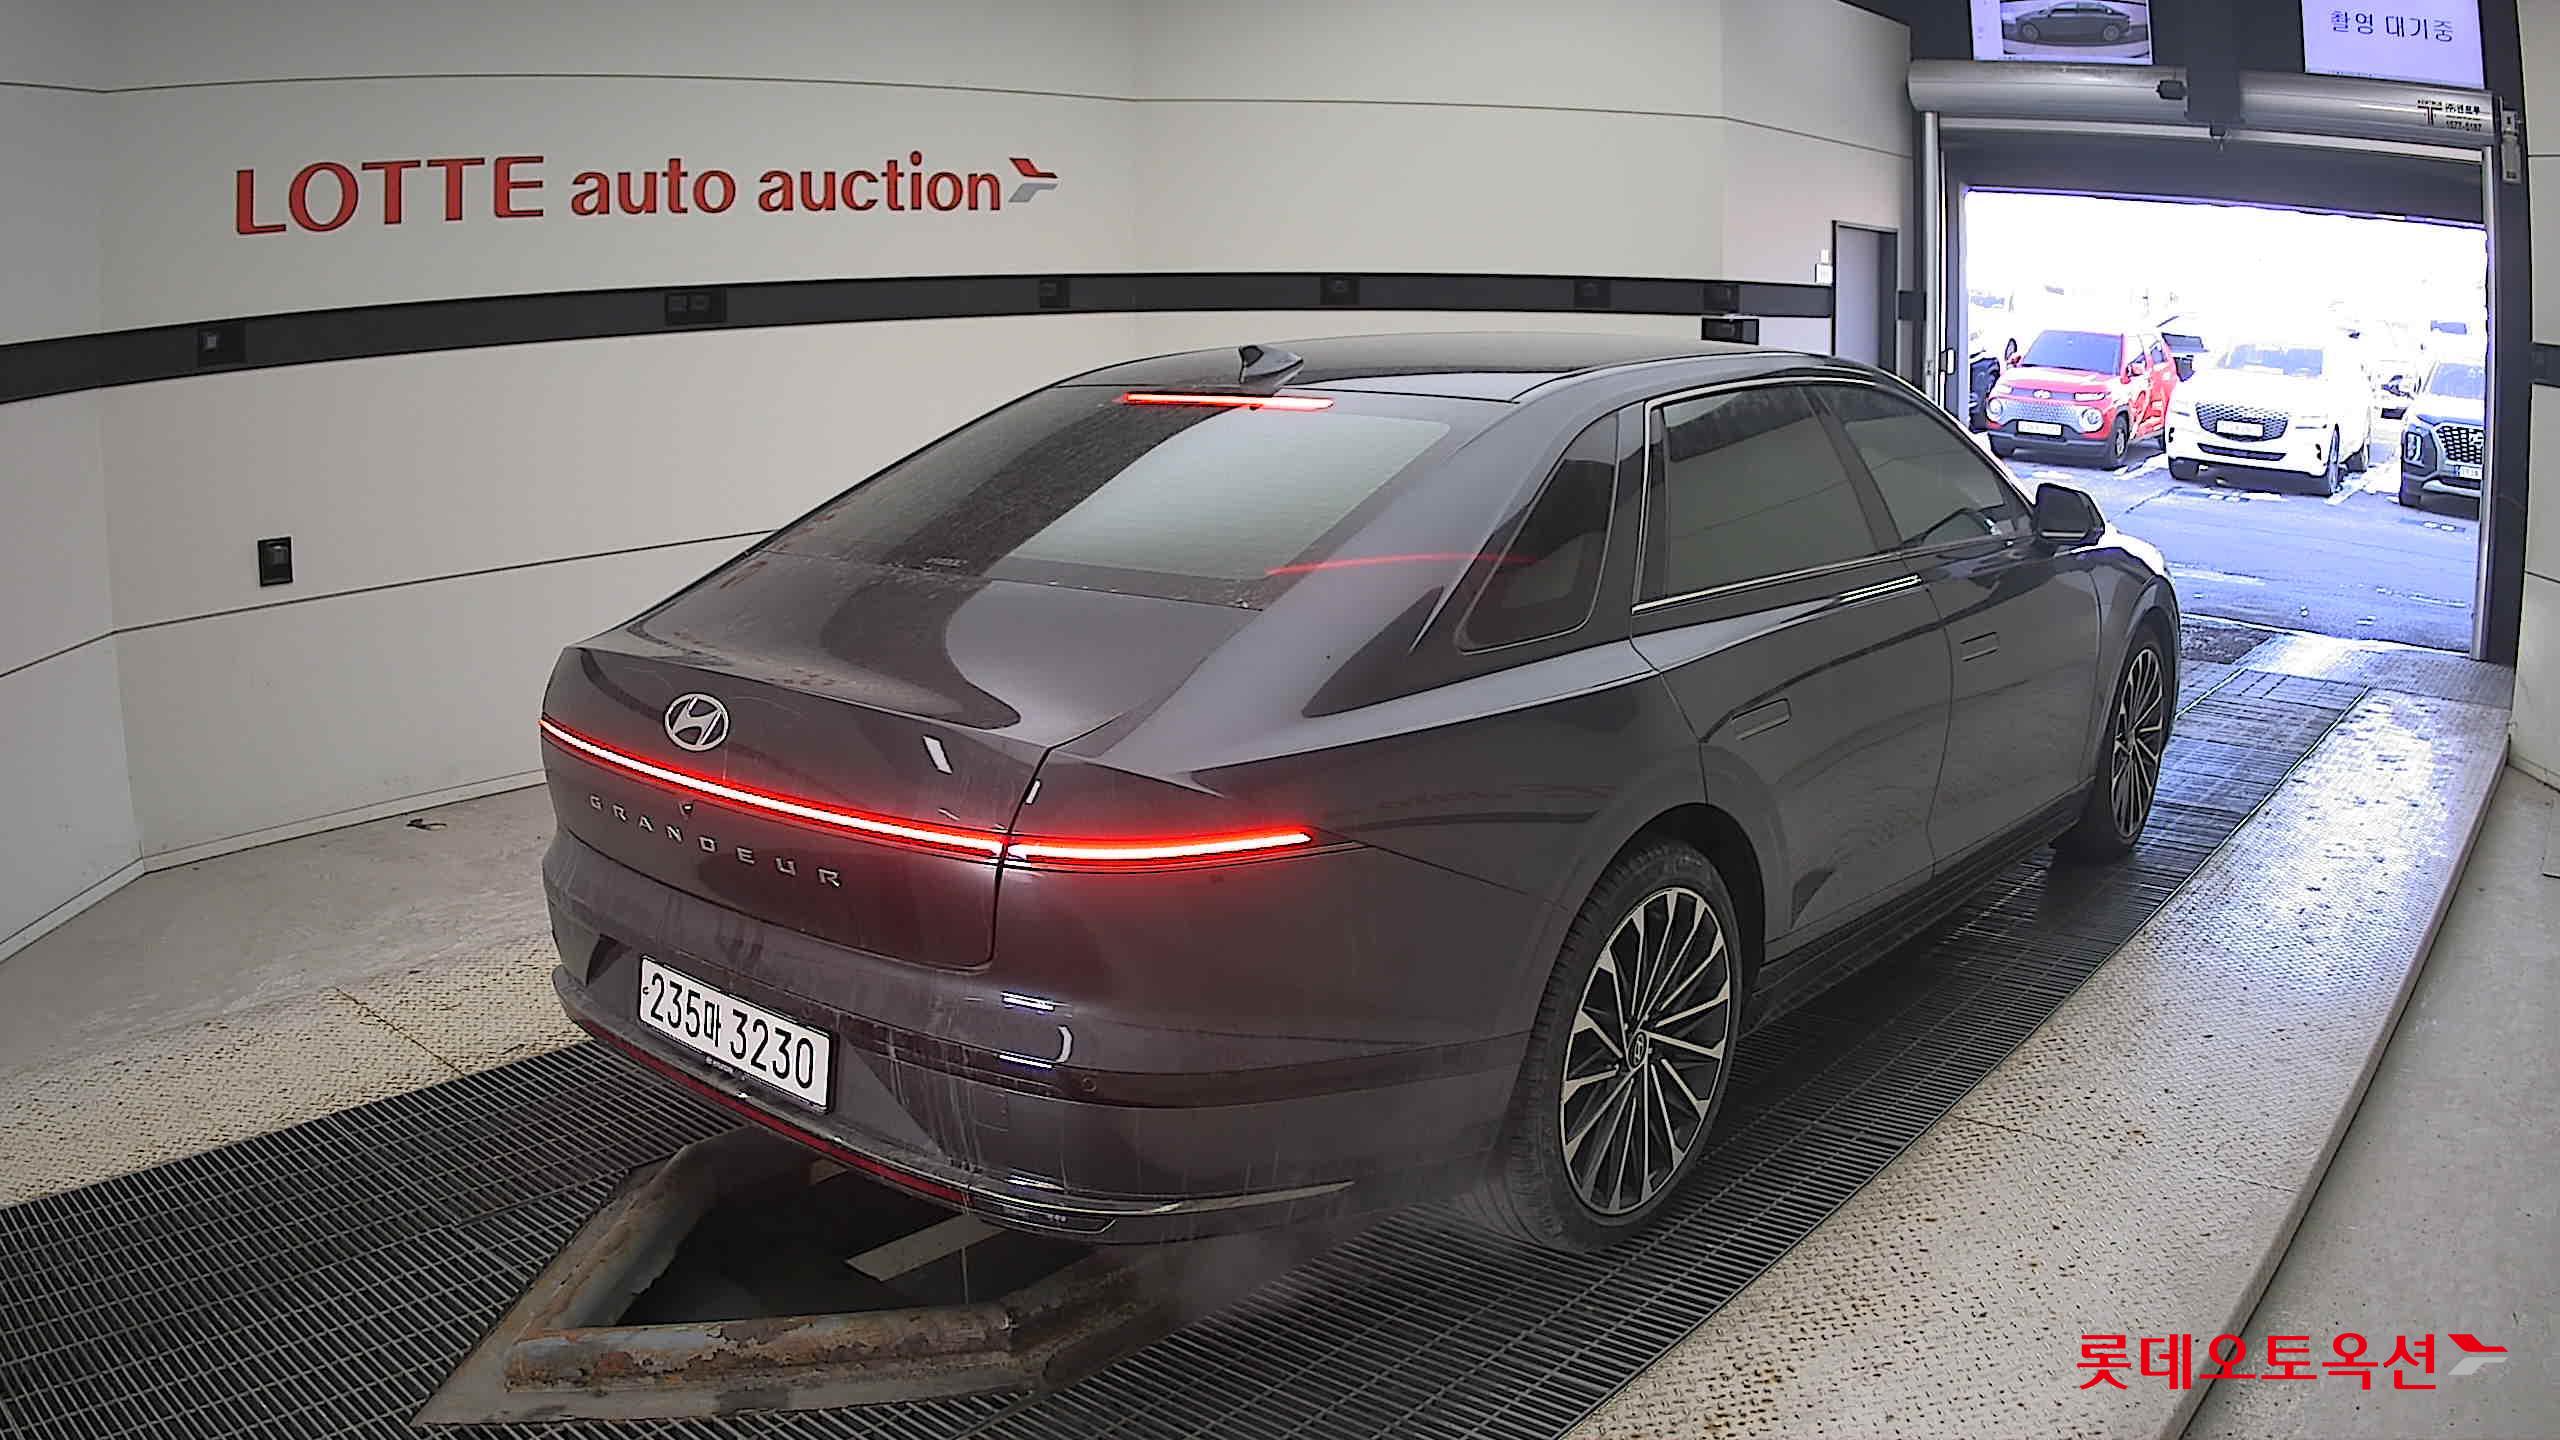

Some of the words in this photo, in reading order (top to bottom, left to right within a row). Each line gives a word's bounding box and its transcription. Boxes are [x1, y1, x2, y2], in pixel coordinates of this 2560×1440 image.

[2331, 10, 2374, 35] 촬영
[2385, 15, 2453, 42] 대기중
[237, 156, 544, 235] LOTTE
[572, 159, 736, 214] auto
[759, 151, 1000, 211] auction
[588, 793, 842, 888] GRANDEUR
[650, 972, 722, 1048] 235마
[730, 1009, 814, 1089] 3230
